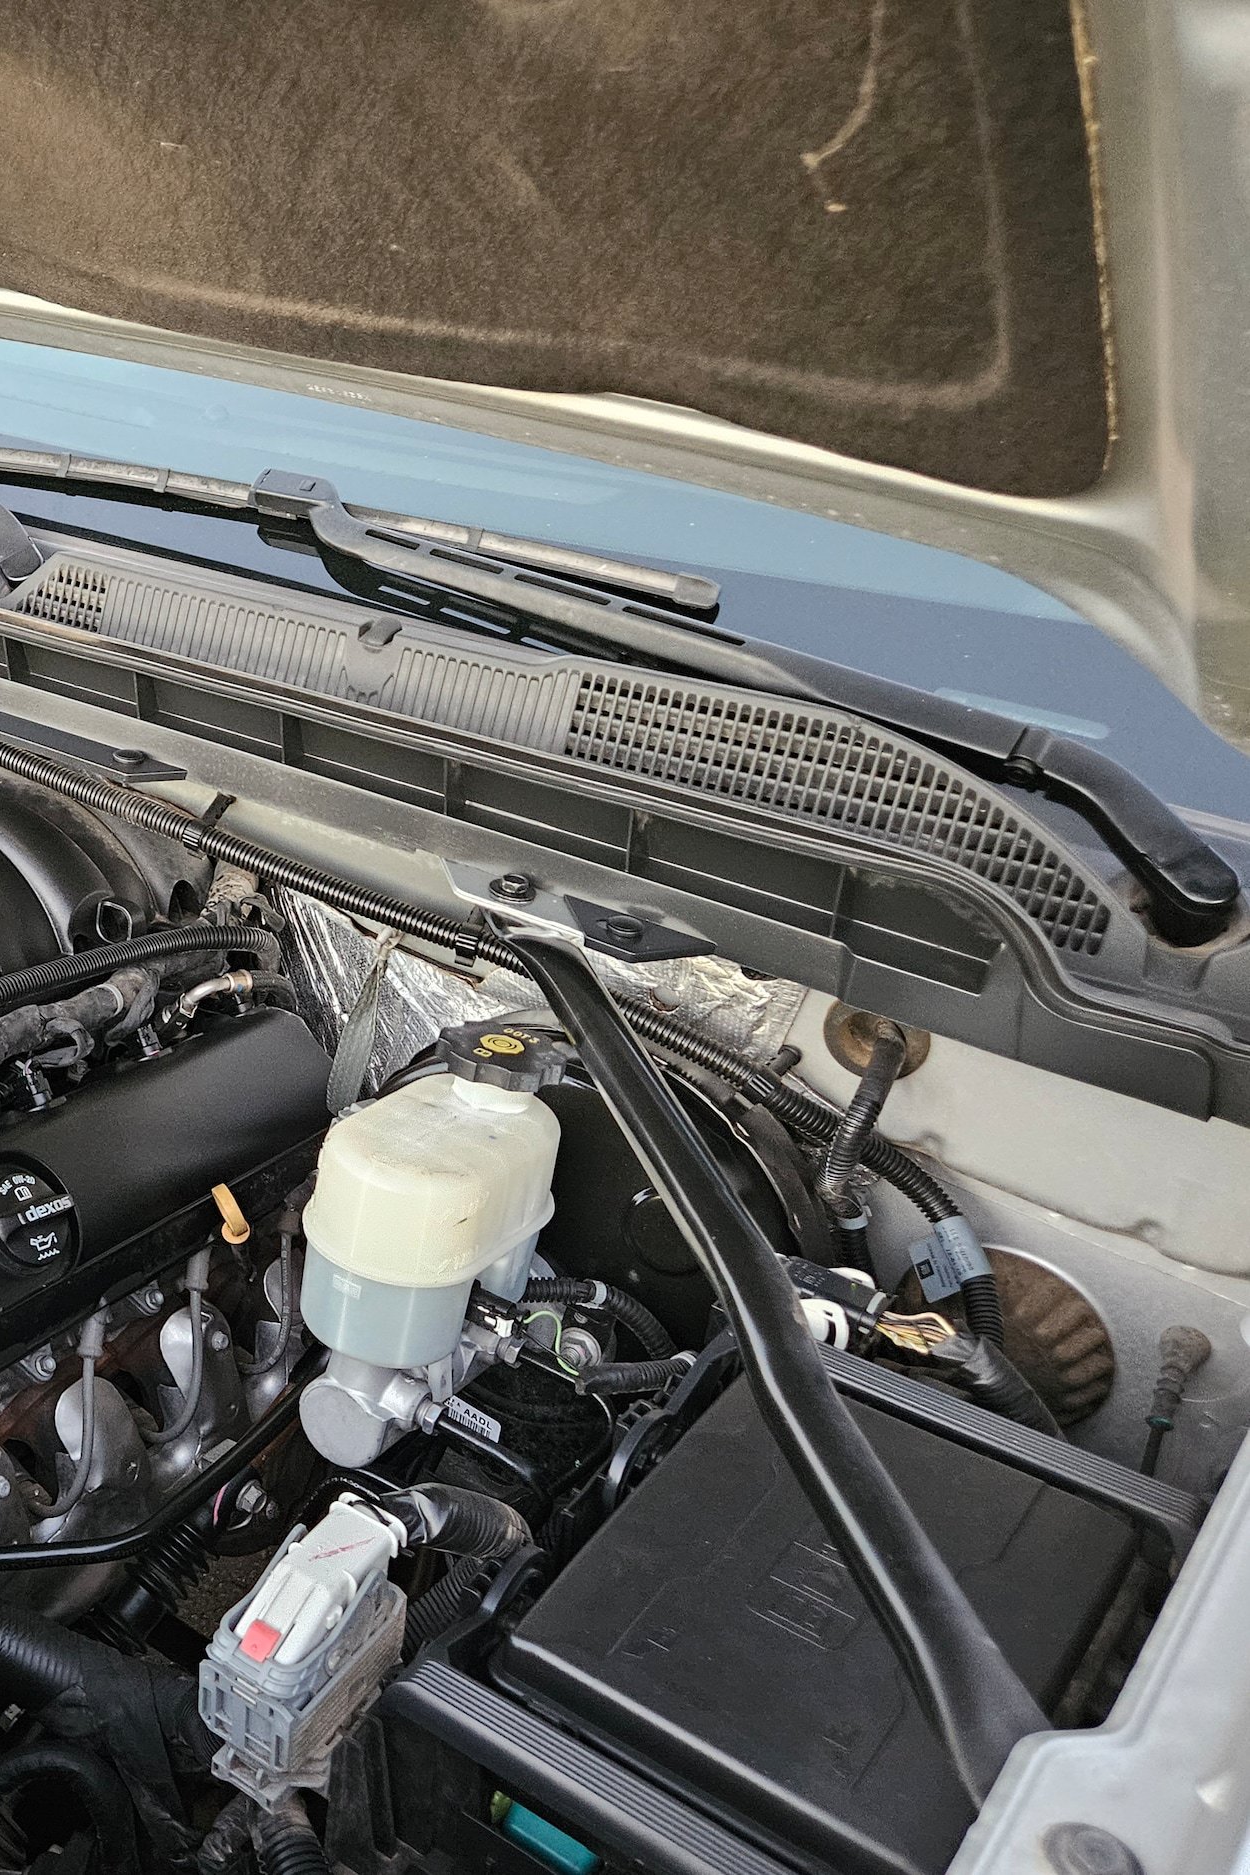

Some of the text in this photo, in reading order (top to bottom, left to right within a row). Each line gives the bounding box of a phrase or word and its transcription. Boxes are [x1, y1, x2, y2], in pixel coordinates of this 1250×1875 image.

[12, 1174, 36, 1185] 0W-20
[25, 1195, 72, 1222] dexos
[464, 1408, 493, 1431] AADL
